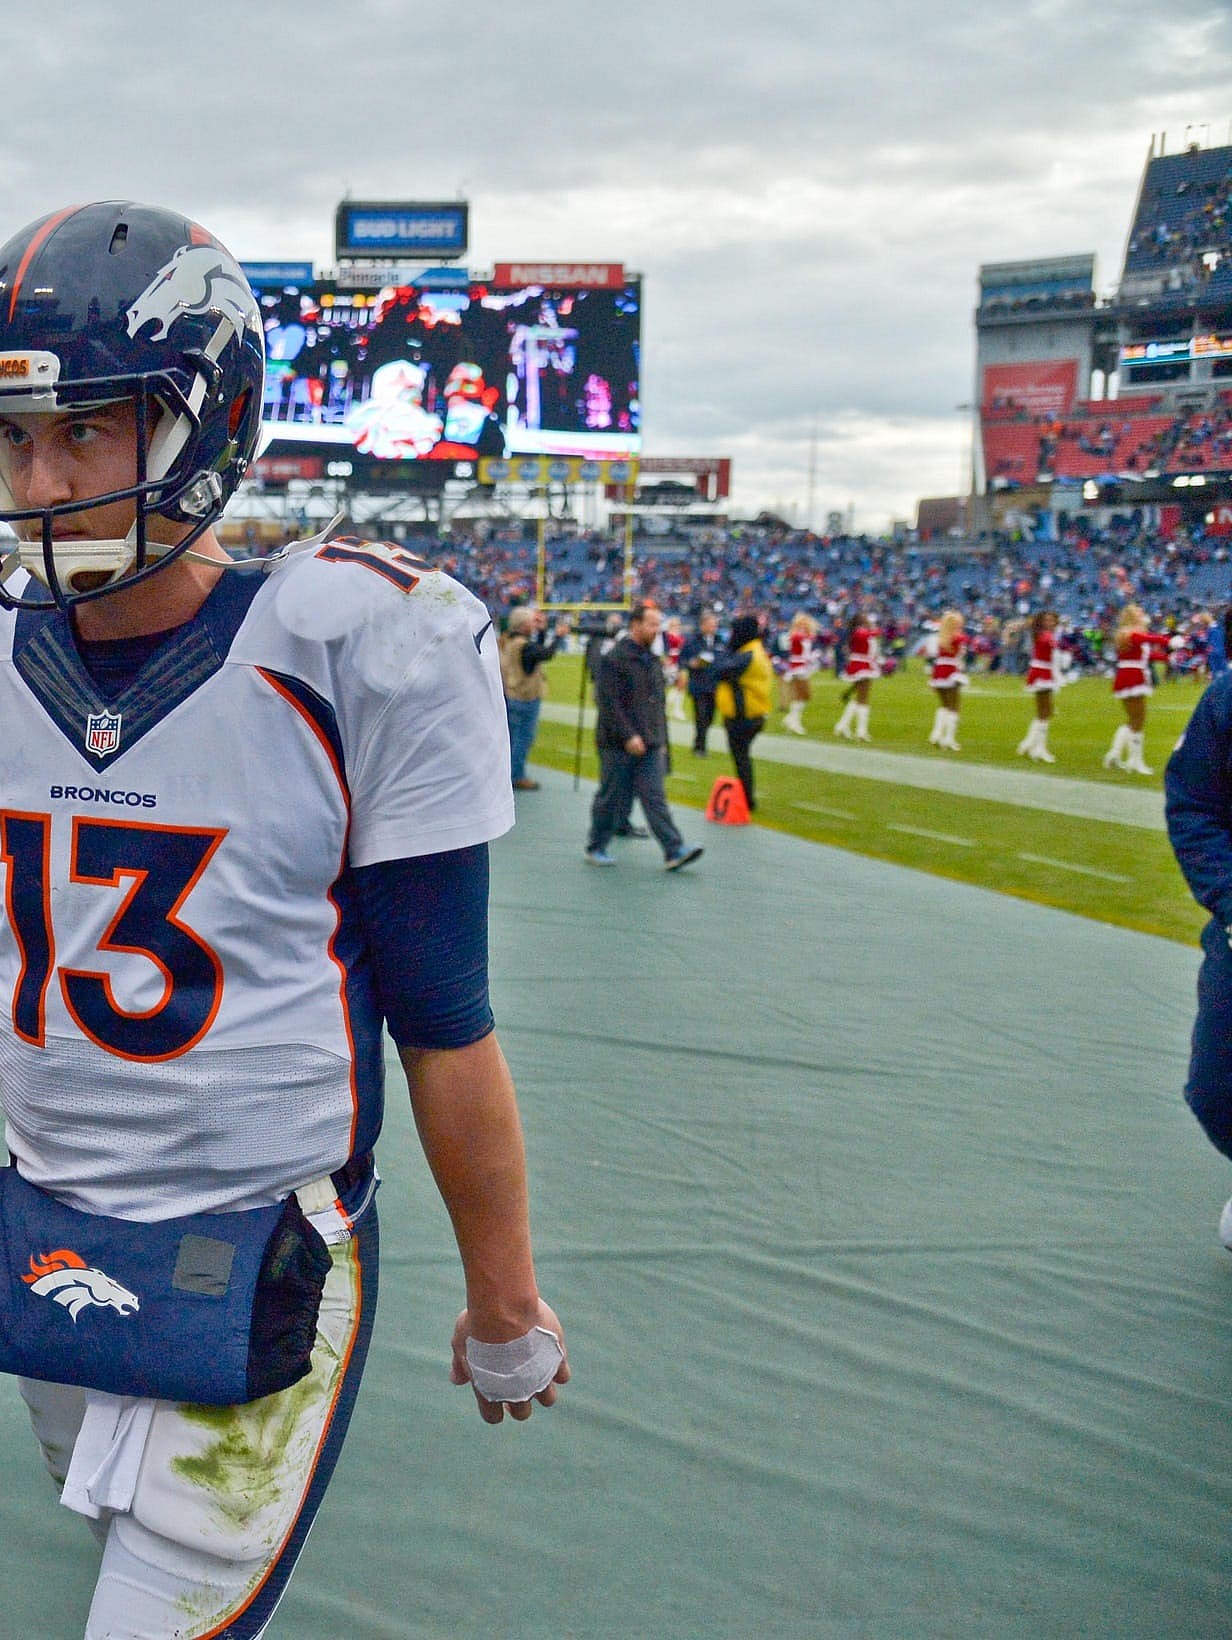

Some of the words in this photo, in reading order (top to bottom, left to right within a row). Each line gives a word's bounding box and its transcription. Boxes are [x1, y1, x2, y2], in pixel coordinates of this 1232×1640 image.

[353, 219, 396, 238] BUD
[398, 219, 456, 238] LIGHT
[510, 266, 609, 285] NISSAN
[91, 731, 115, 750] NFL
[50, 785, 157, 808] BRONCOS
